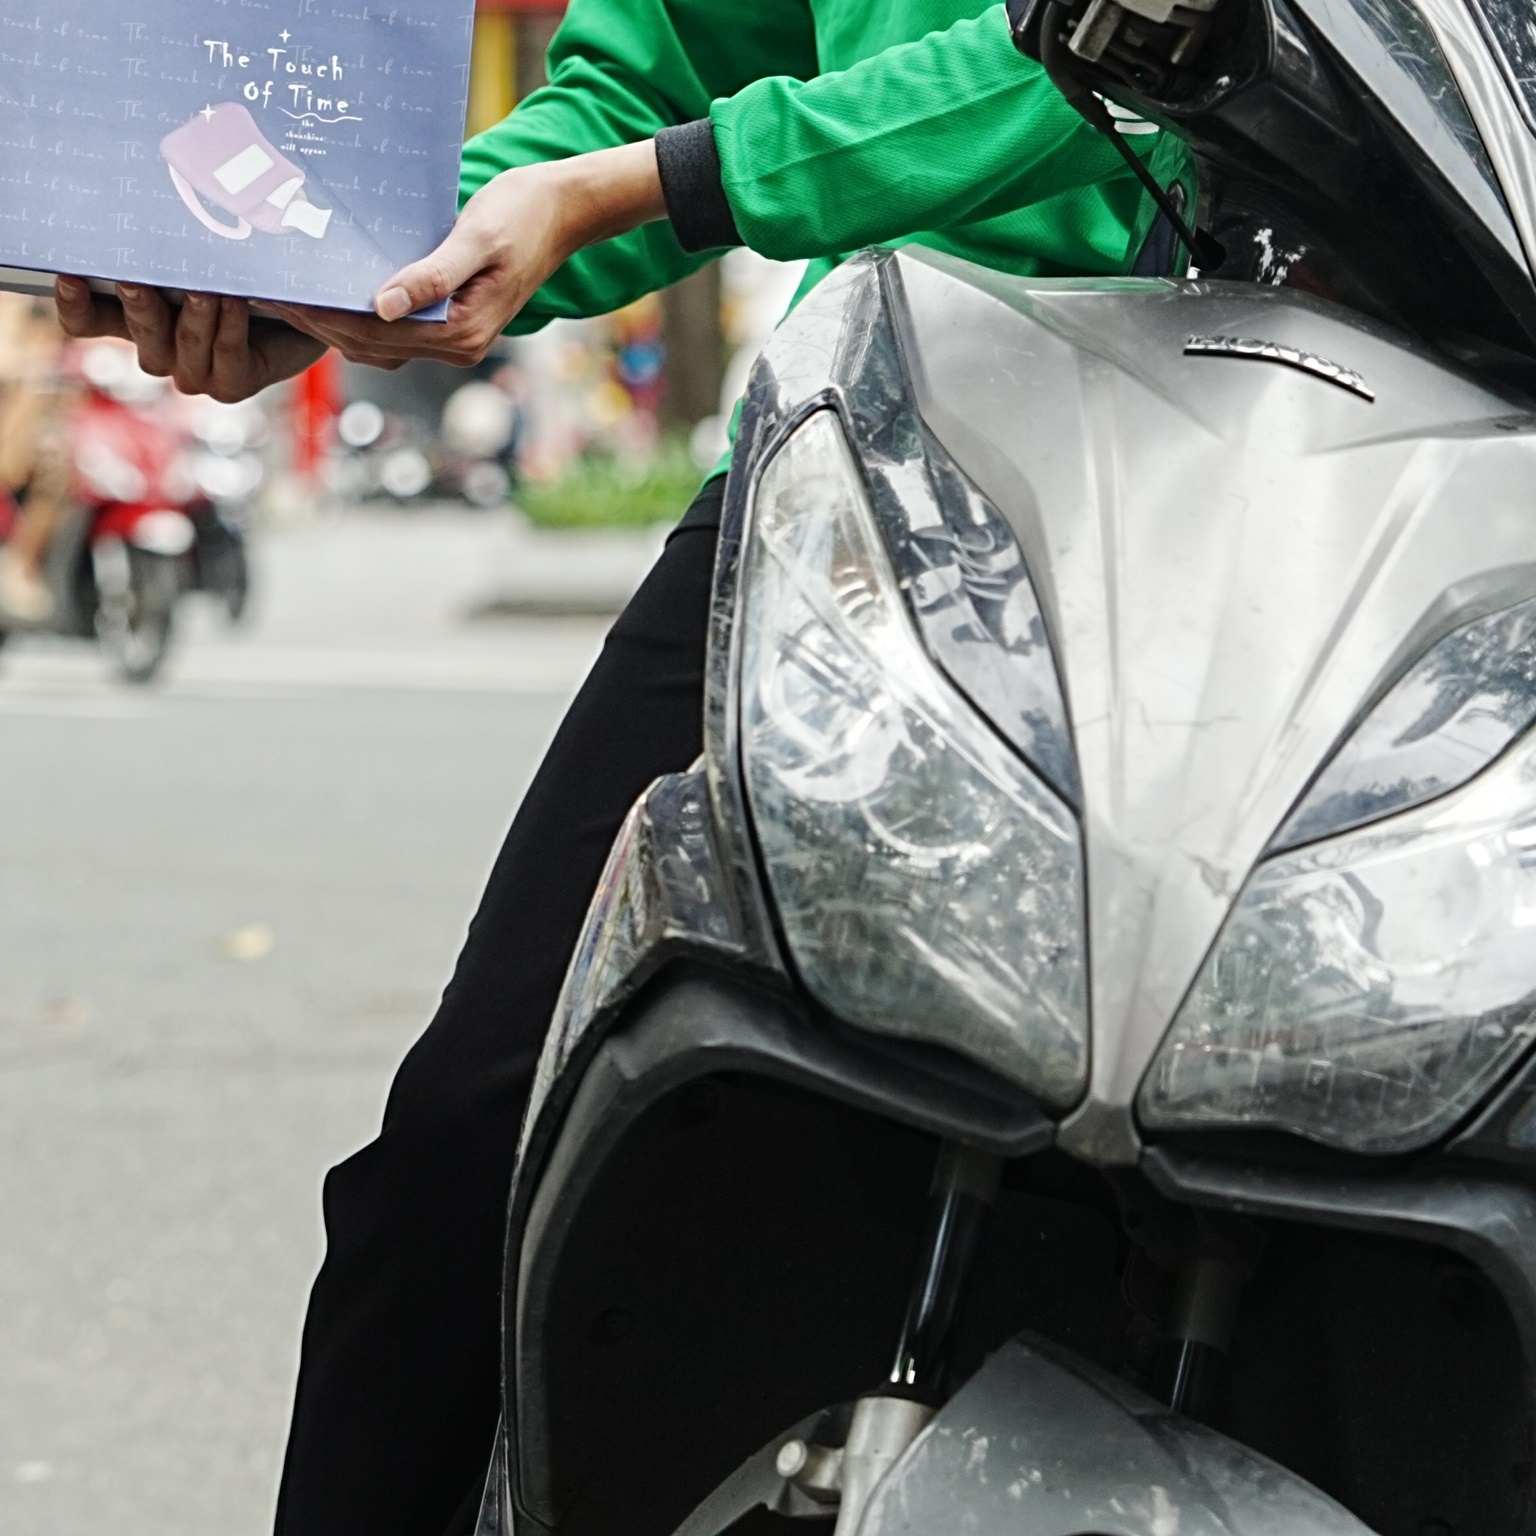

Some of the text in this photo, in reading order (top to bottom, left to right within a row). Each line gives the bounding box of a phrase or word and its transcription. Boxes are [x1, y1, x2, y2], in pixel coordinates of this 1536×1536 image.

[121, 22, 149, 42] The
[120, 57, 149, 78] The
[204, 40, 250, 68] The
[267, 48, 343, 81] Touch
[244, 80, 274, 109] Of
[288, 84, 349, 113] Time
[117, 100, 146, 120] The
[116, 141, 145, 161] The
[113, 177, 141, 197] The
[108, 213, 138, 232] The
[275, 236, 305, 257] The
[108, 248, 138, 268] The
[275, 271, 306, 291] The
